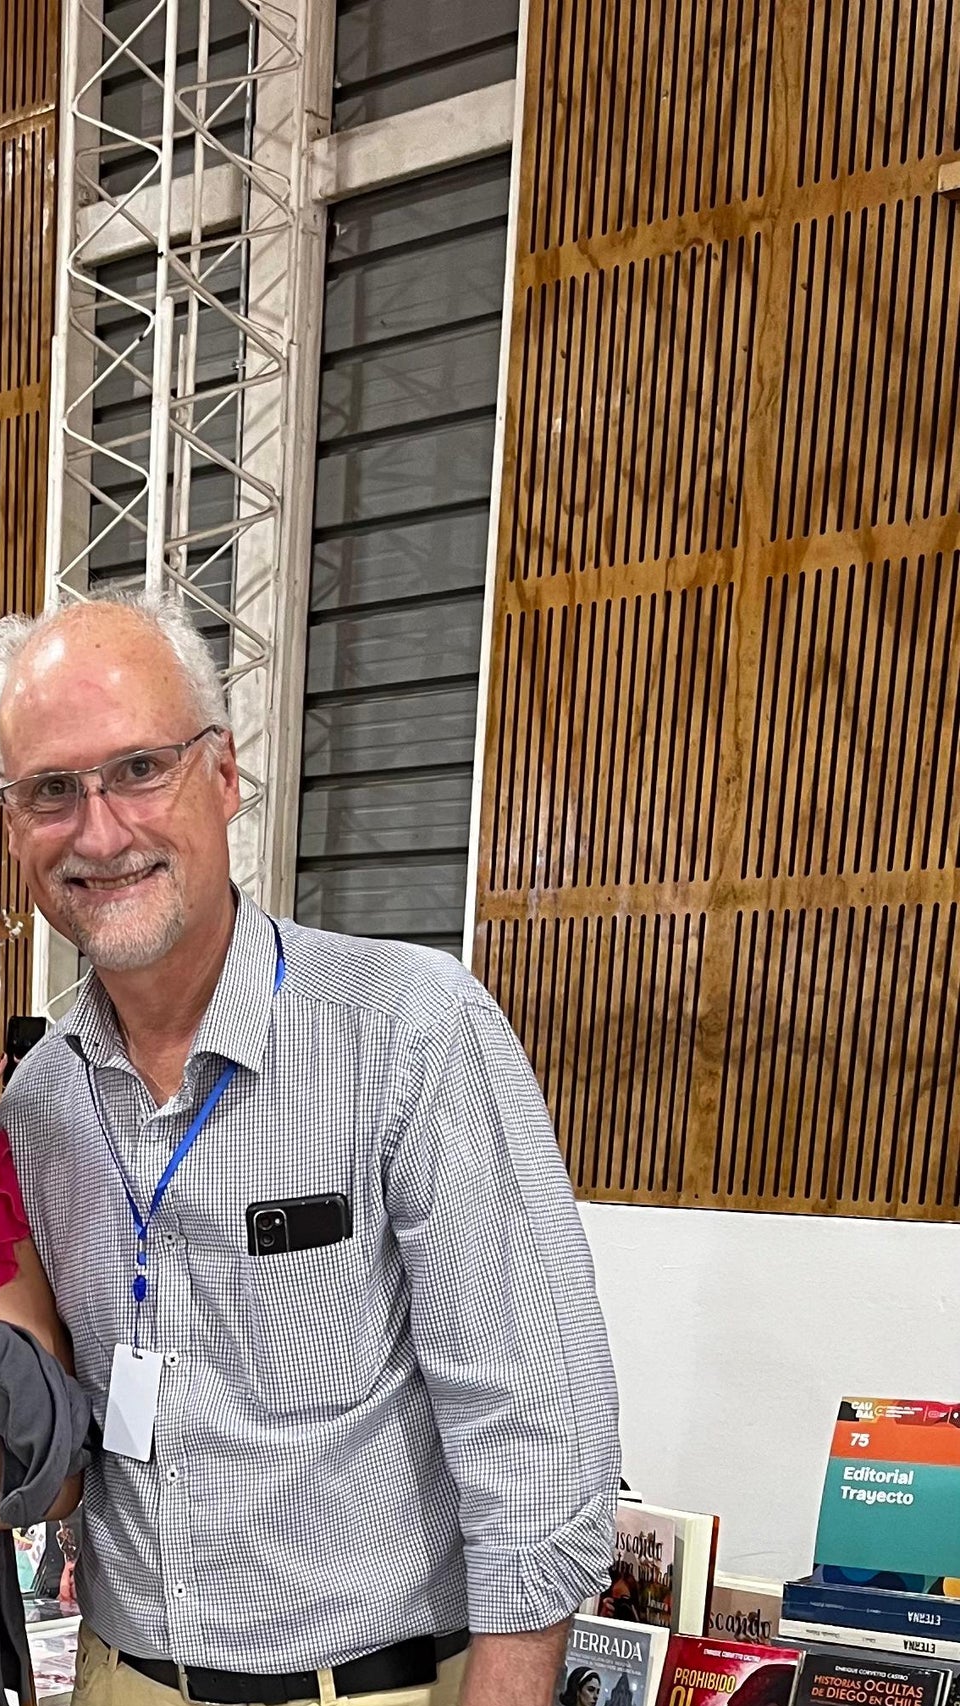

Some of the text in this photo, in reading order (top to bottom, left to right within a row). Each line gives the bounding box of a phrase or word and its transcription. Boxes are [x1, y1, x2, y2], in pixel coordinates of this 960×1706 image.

[850, 1432, 870, 1447] 75
[843, 1466, 914, 1485] Editorial
[841, 1486, 914, 1505] Trayecto
[908, 1611, 942, 1626] ETERNA
[572, 1629, 643, 1662] TERRADA
[903, 1639, 936, 1654] ETERNA
[673, 1667, 737, 1693] PROHIBIDO
[813, 1674, 924, 1699] HISTORIAS OCULTAS
[811, 1687, 825, 1697] DE
[826, 1687, 868, 1703] DIEGO
[869, 1695, 883, 1706] EN
